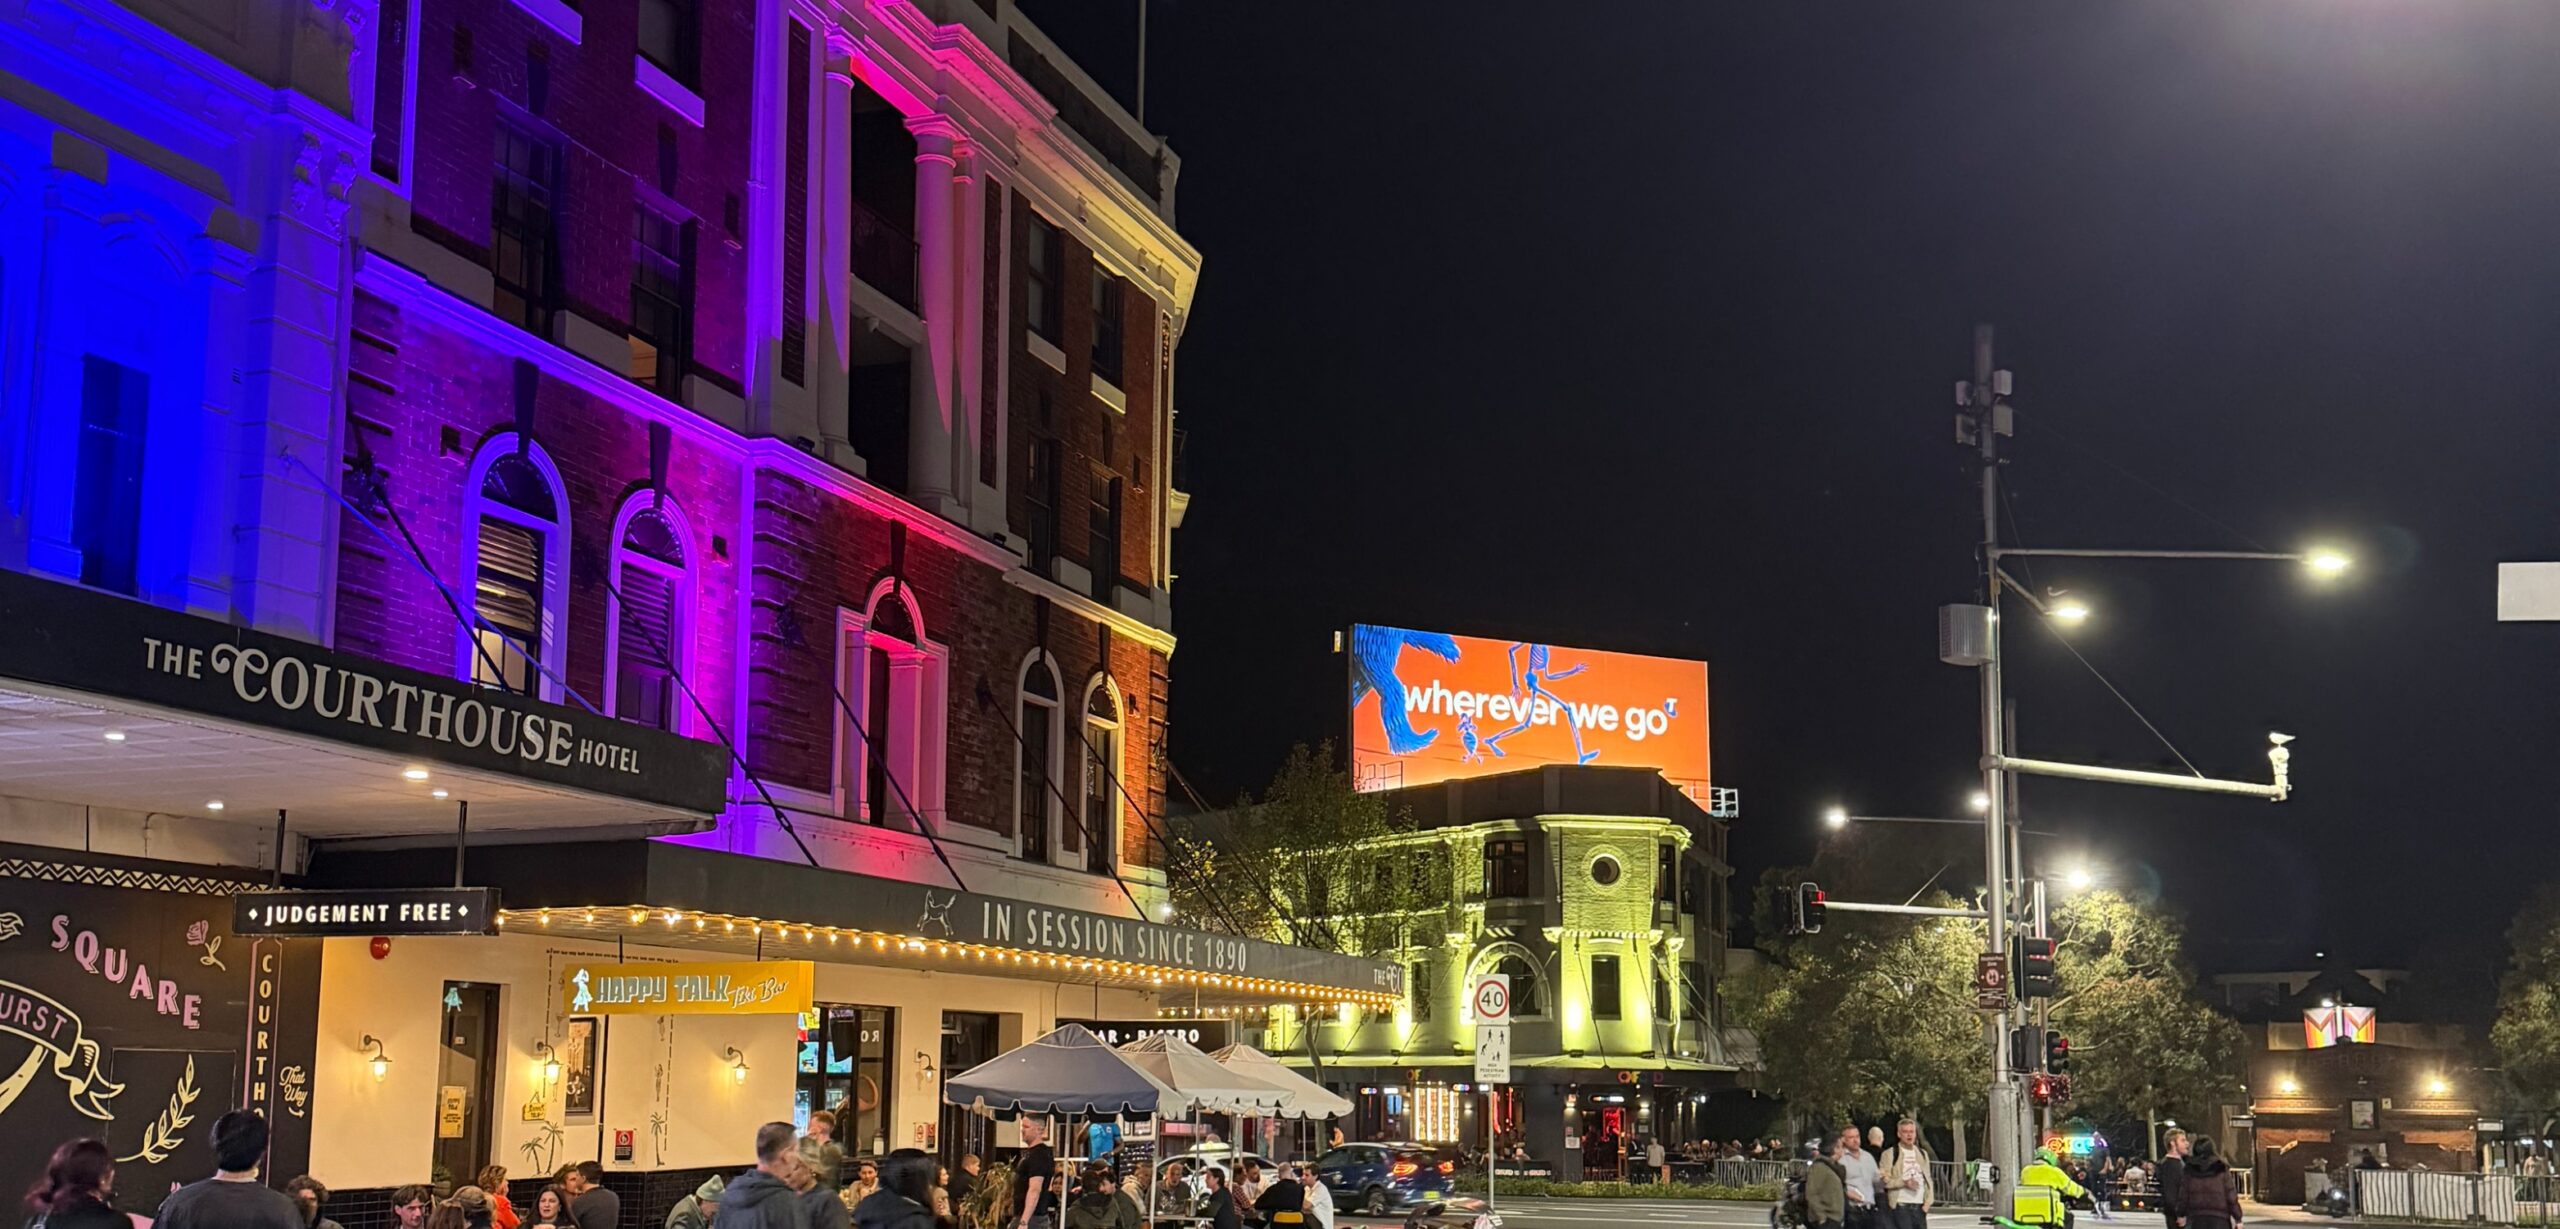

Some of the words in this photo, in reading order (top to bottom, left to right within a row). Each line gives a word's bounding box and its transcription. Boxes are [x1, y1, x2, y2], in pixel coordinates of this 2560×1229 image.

[143, 637, 203, 679] THE
[210, 643, 574, 768] COURTHOUSE
[579, 740, 640, 774] HOTEL
[1402, 679, 1566, 726] wherever
[1570, 703, 1619, 732] we
[1625, 706, 1669, 741] go
[264, 904, 390, 926] JUDGEMENT
[399, 903, 452, 922] FREE
[983, 902, 1011, 941] IN
[1027, 909, 1125, 956] SESSION
[1137, 926, 1194, 965] SINCE
[1204, 937, 1247, 972] 1890
[51, 914, 201, 1029] SQUARE
[1374, 968, 1386, 986] THE
[595, 976, 667, 1003] HAPPY
[673, 975, 731, 1002] TALK
[758, 977, 789, 1003] Bar
[1481, 991, 1504, 1008] 40
[253, 953, 273, 1118] COURTH
[1089, 1029, 1118, 1043] AR
[278, 1065, 306, 1087] That
[283, 1084, 308, 1107] Way
